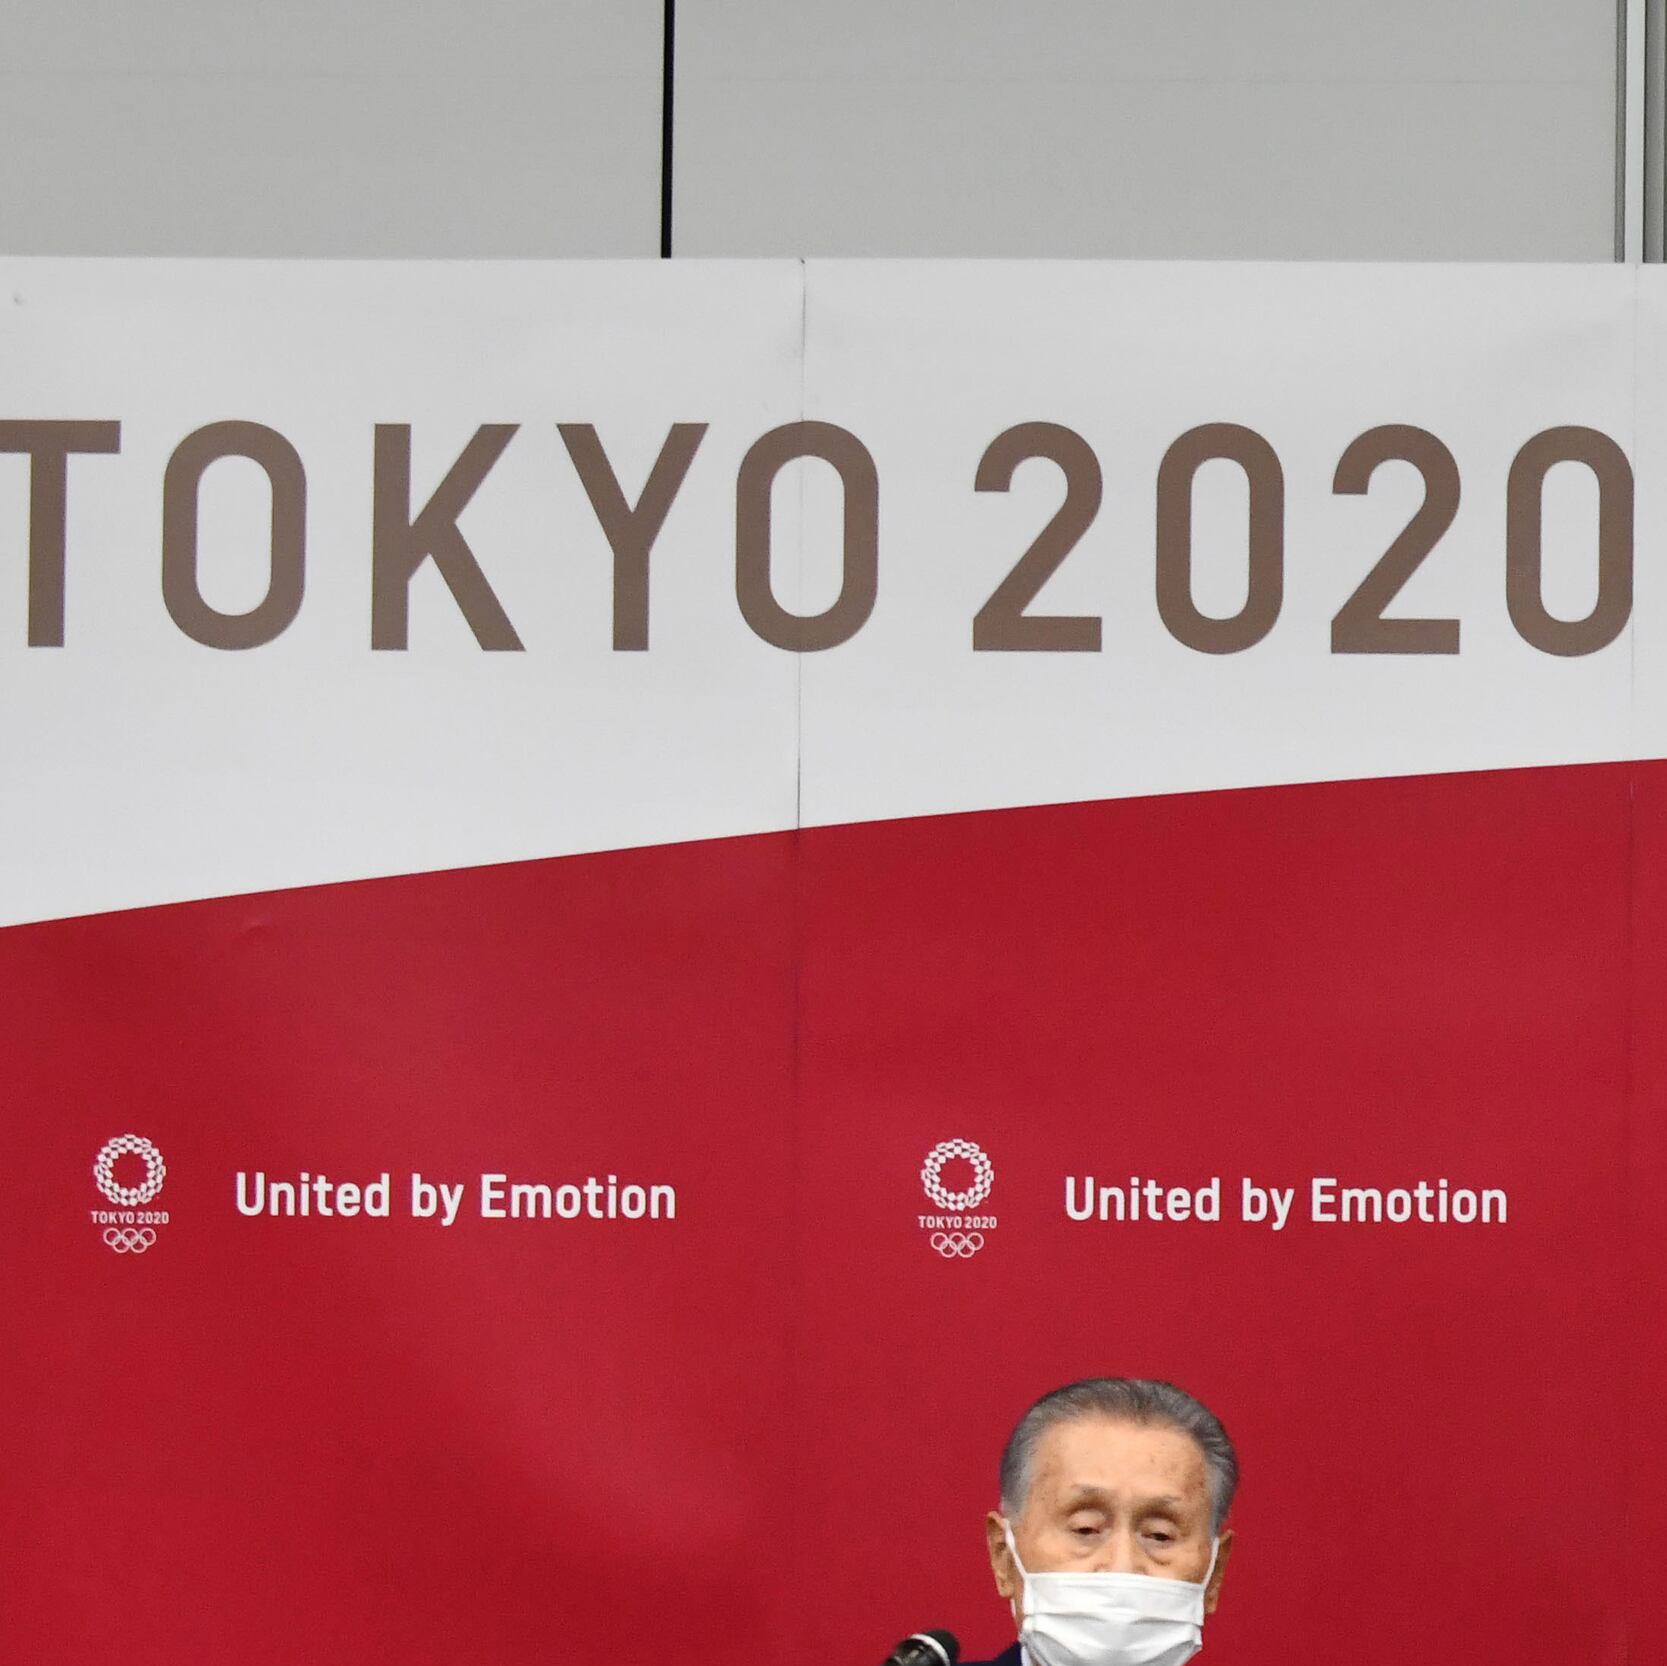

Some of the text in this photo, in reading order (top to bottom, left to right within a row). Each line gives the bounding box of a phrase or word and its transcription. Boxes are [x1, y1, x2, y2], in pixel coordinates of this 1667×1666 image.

[0, 419, 1635, 658] TOKYO 2020
[91, 1211, 170, 1225] TOKYO 2020
[236, 1172, 676, 1227] United by Emotion
[918, 1215, 998, 1229] TOKYO 2020
[1065, 1176, 1507, 1231] United by Emotion
